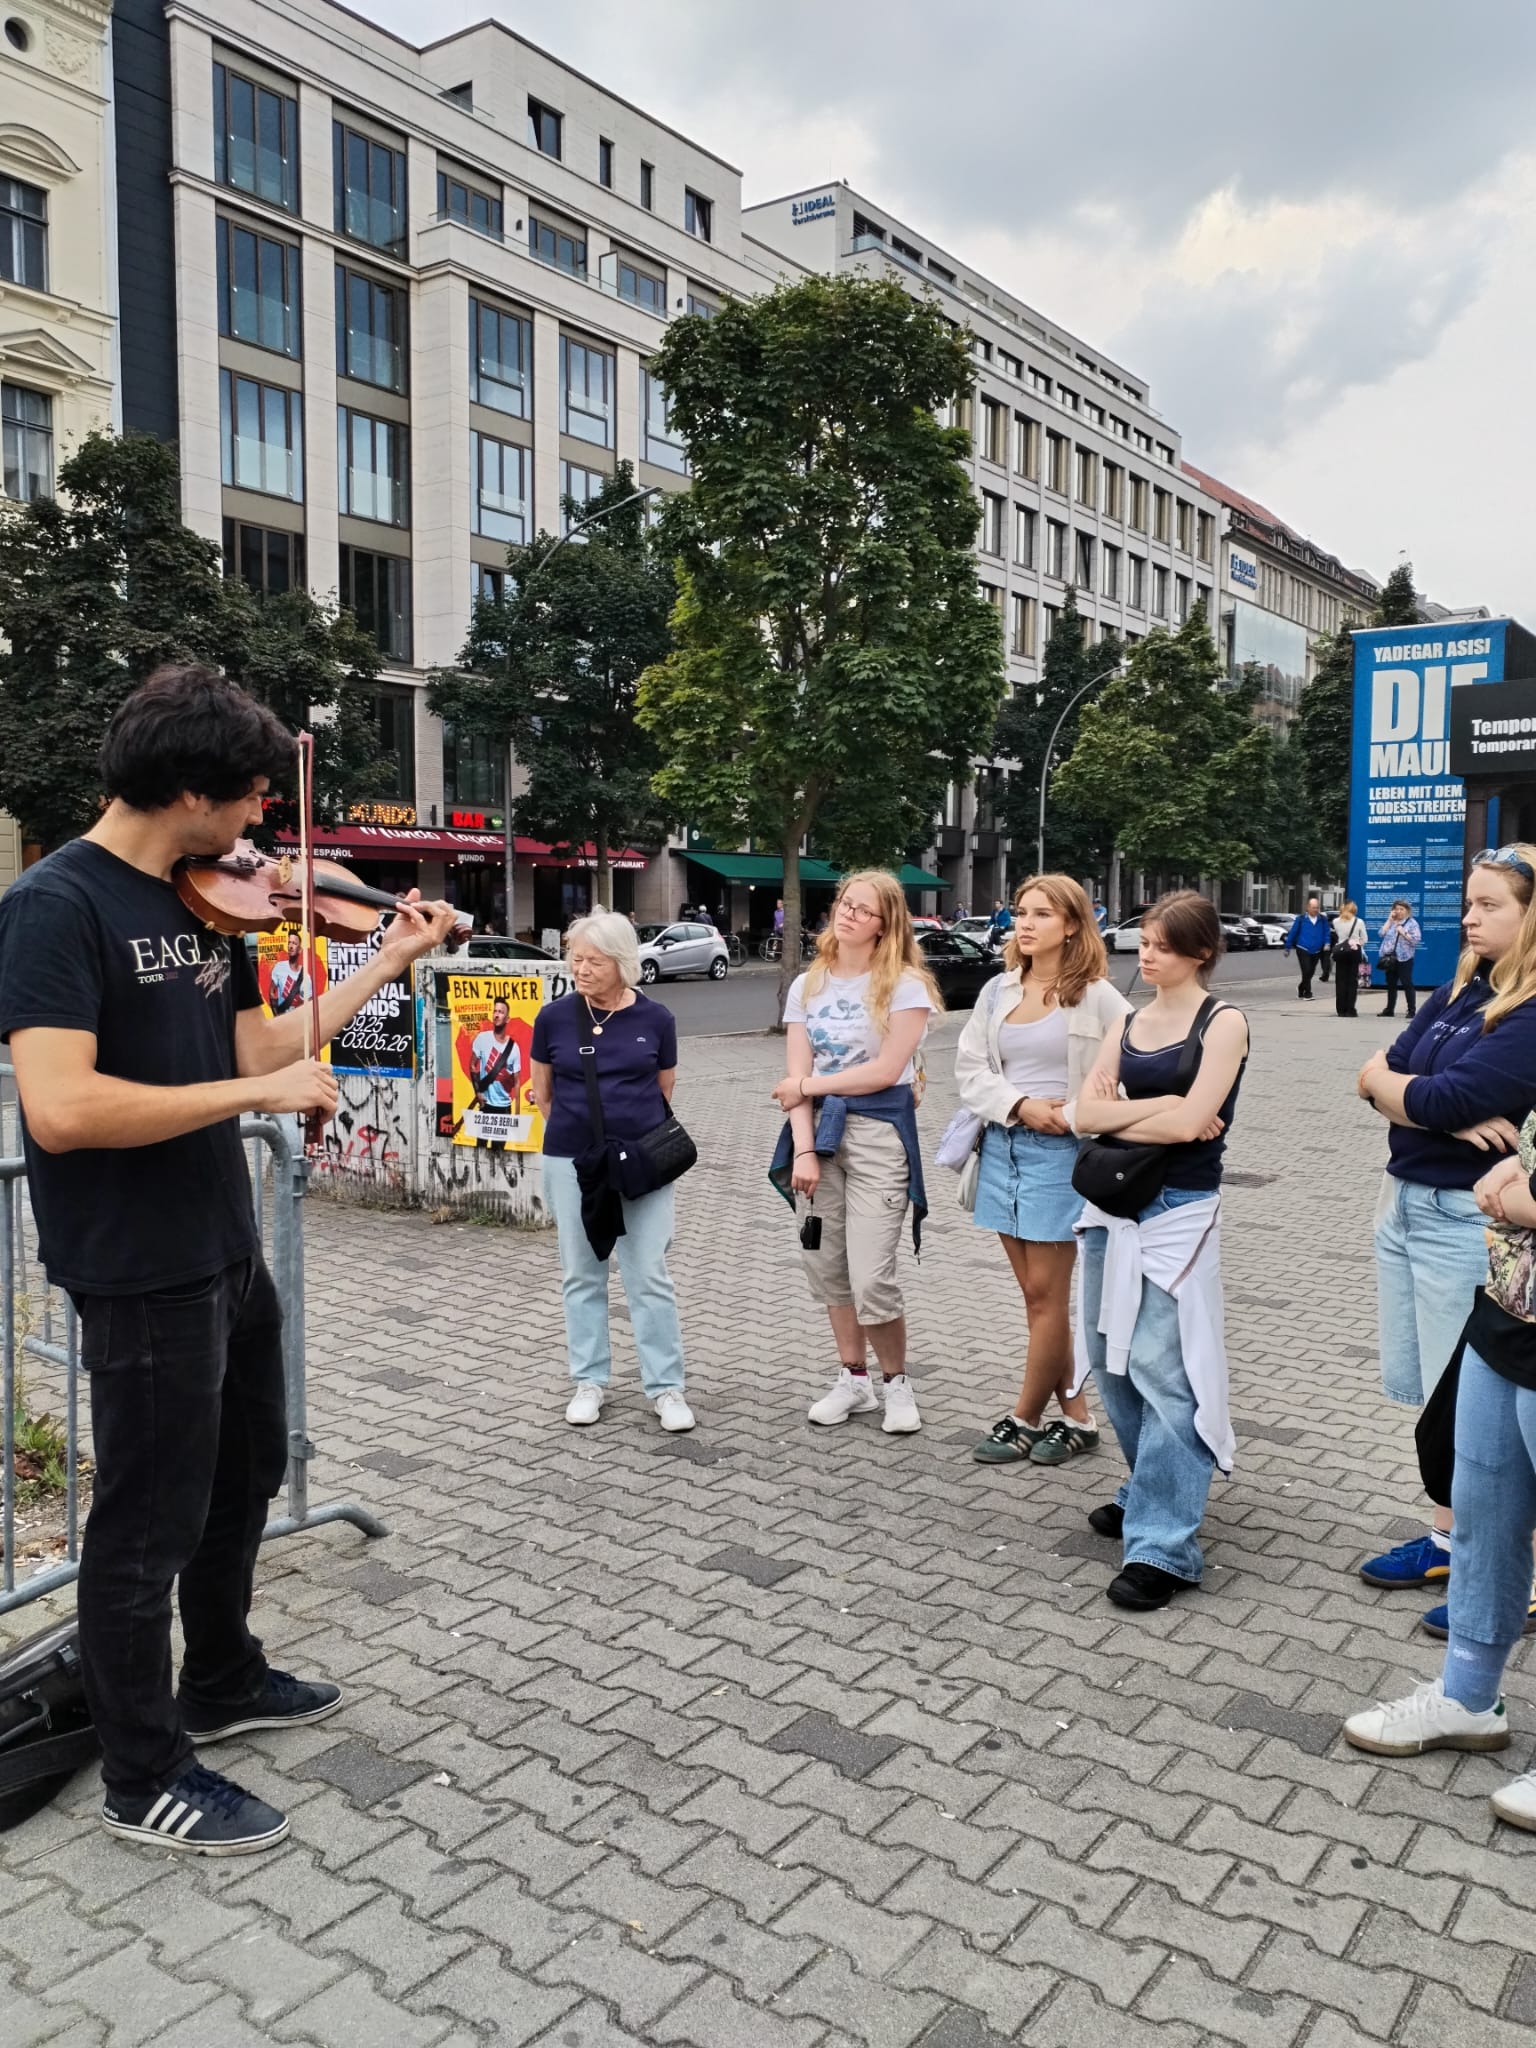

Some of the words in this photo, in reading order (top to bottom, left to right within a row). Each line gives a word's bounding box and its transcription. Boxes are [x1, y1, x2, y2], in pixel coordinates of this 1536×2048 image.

[804, 195, 835, 213] IDEAL
[1374, 642, 1443, 662] YADEGAR
[1446, 638, 1491, 657] ASISI
[1369, 741, 1450, 778] MAU
[1369, 787, 1405, 800] LEBEN
[1408, 785, 1432, 799] MIT
[1434, 785, 1462, 798] DEM
[349, 803, 416, 826] MUNDO
[1369, 799, 1466, 815] TODESSTREIFEN
[452, 811, 485, 829] BAR
[1368, 815, 1392, 824] LIVING
[1393, 815, 1412, 823] WITH
[1414, 815, 1427, 823] THE
[1428, 814, 1451, 822] DEATH
[313, 847, 353, 858] ESPAÑOL
[458, 854, 485, 863] MUNDO
[138, 973, 165, 984] TOUR
[454, 981, 483, 999] BEN
[484, 982, 539, 1000] ZUCKER
[499, 1116, 519, 1128] BERLIN
